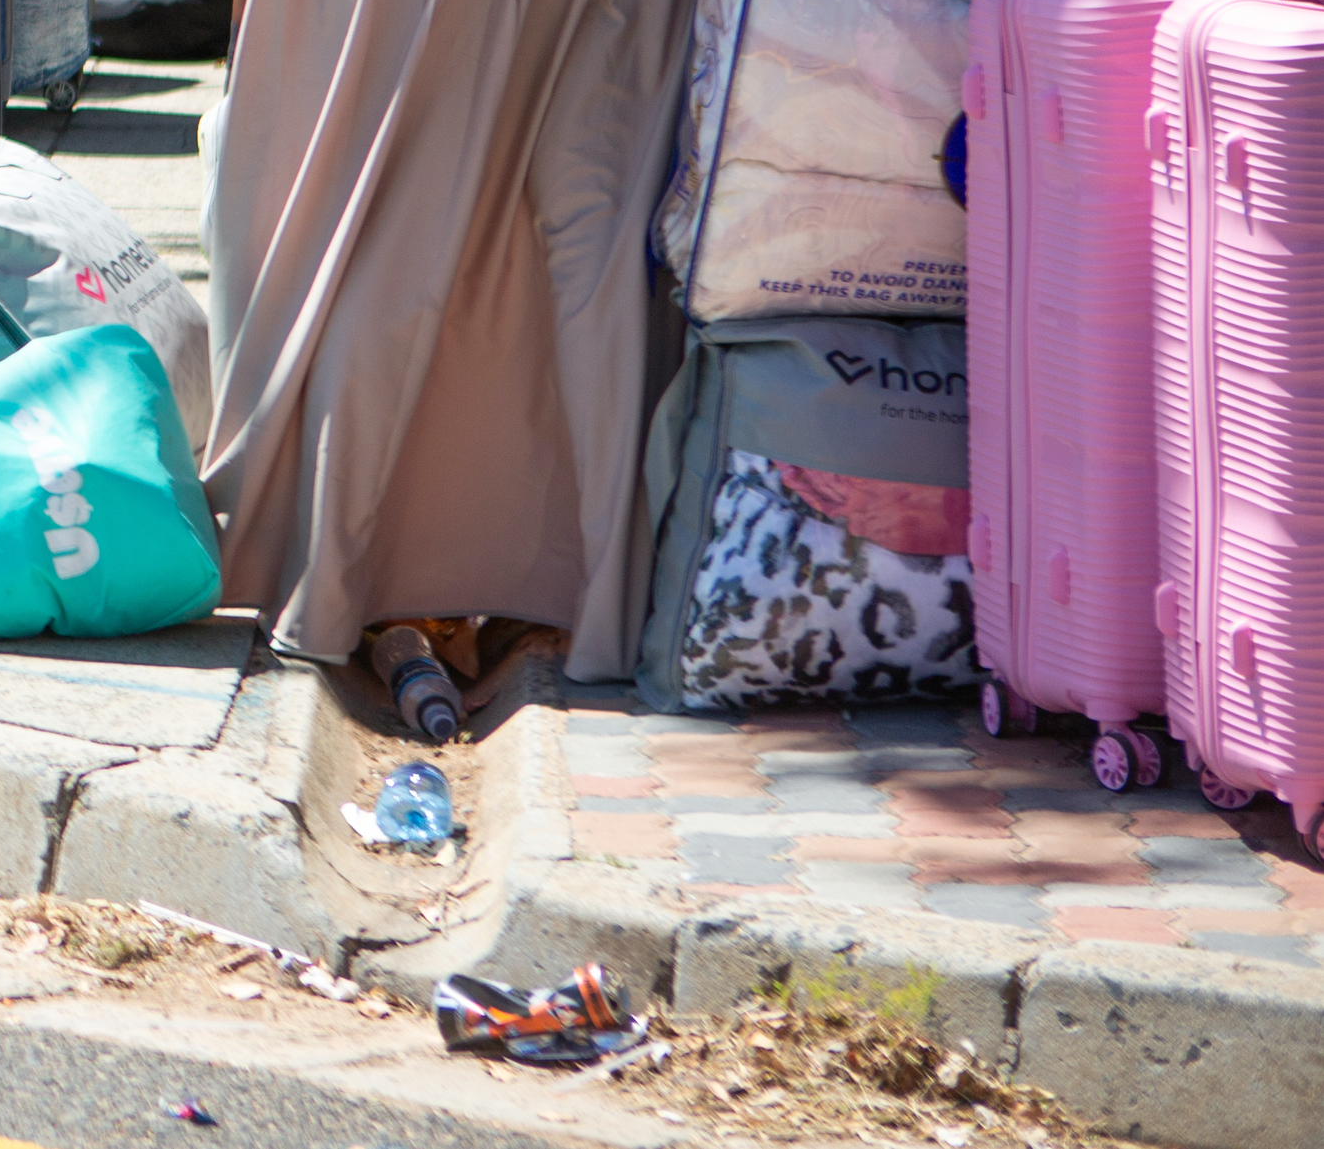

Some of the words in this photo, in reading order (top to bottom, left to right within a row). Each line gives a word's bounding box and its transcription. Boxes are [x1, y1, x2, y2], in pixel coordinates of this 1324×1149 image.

[759, 279, 803, 293] KEEP
[808, 284, 849, 298] THIS
[854, 288, 891, 301] BAG
[898, 292, 951, 305] AWAY
[830, 270, 854, 283] TO
[858, 273, 917, 288] AVOID
[922, 278, 968, 292] DAN
[909, 408, 937, 422] the
